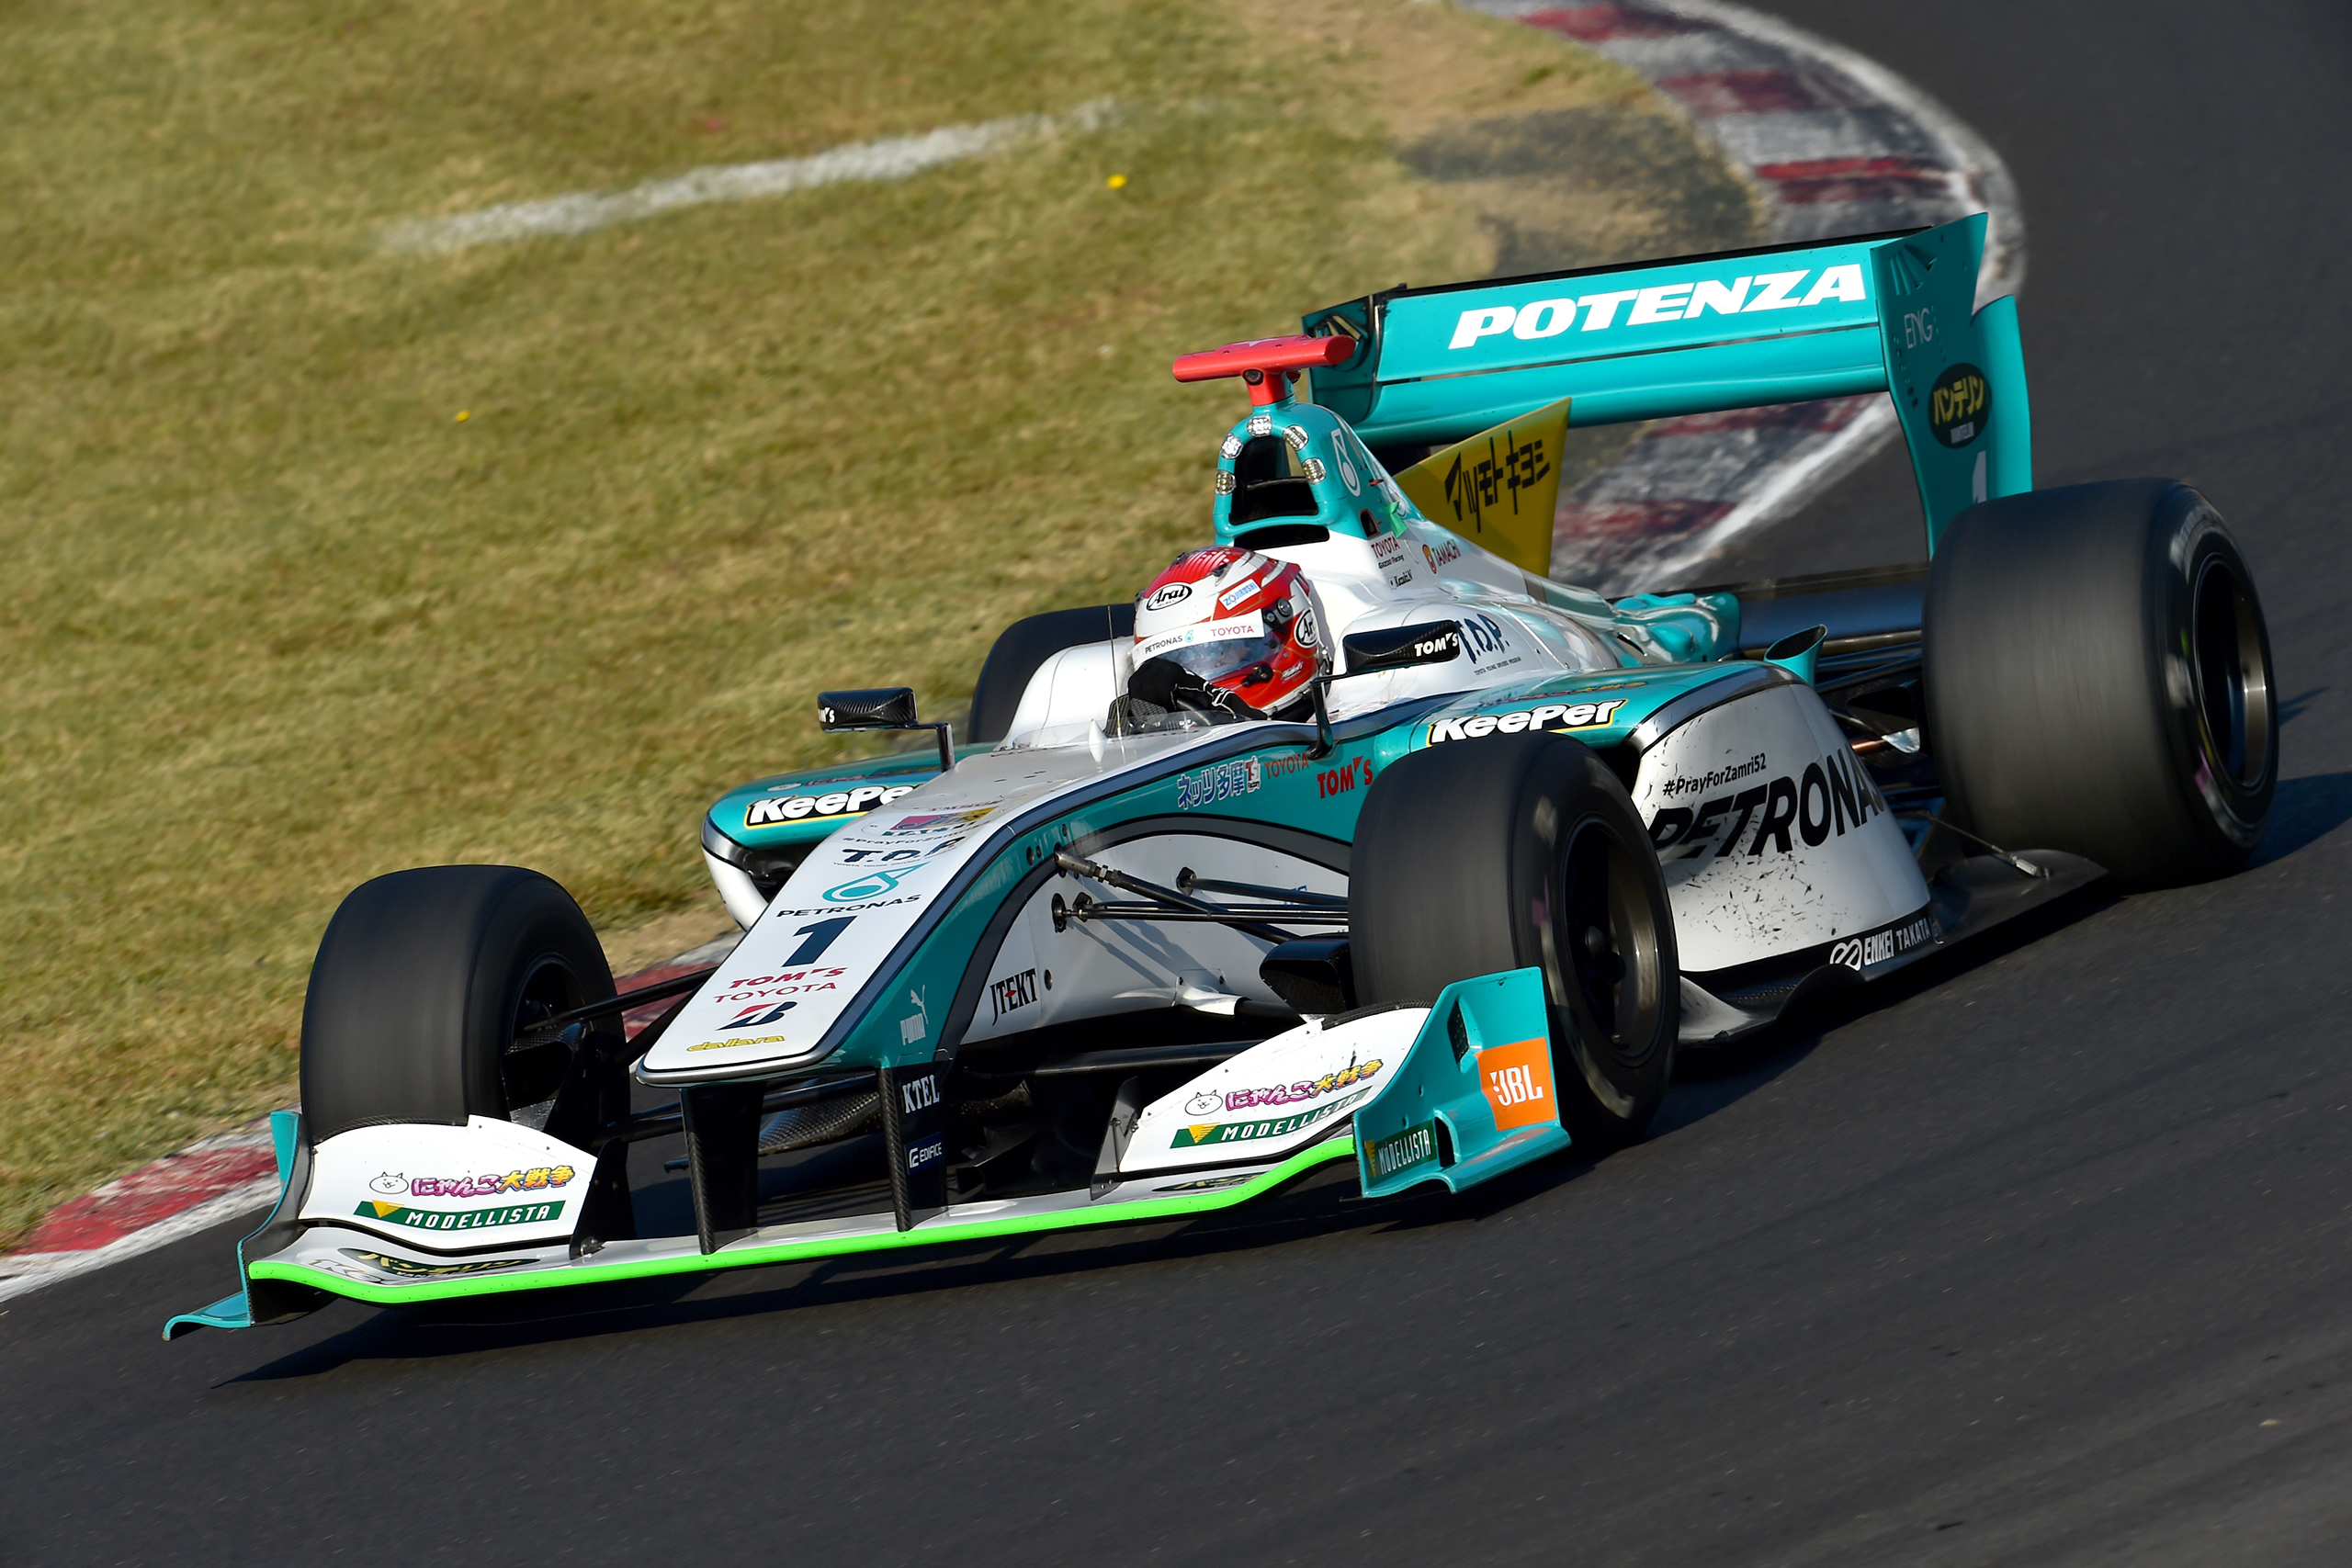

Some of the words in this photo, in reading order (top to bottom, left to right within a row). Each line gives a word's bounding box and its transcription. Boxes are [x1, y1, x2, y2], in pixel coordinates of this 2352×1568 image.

[1448, 264, 1866, 350] POTENZA
[1933, 375, 1984, 425] バンテリン
[1371, 536, 1401, 558] TOYOTA
[1148, 585, 1186, 607] Arai
[1145, 635, 1182, 654] PETRONAS
[1211, 626, 1254, 637] TOYOTA
[1414, 632, 1459, 657] TOM'S
[1264, 752, 1310, 779] TOYOTA
[1317, 756, 1374, 799] TOM'S
[1663, 752, 1767, 796] #PrayForZamri52
[1177, 760, 1245, 810] ネッツ多摩
[750, 784, 917, 824] KeePe
[776, 894, 922, 919] PETRONAS
[781, 915, 859, 967] 1
[1863, 929, 1894, 966] ENKEI
[1895, 917, 1931, 951] TAKATA
[714, 981, 838, 1003] TOYOTA
[729, 966, 849, 989] TOM'S
[990, 967, 1038, 1027] JTEKT
[686, 1034, 786, 1052] dallara
[899, 1012, 926, 1045] PUMA
[901, 1075, 940, 1114] KTEL
[1226, 1059, 1384, 1111] にゃんこ大戦争
[1490, 1064, 1544, 1107] JBL
[1221, 1094, 1358, 1141] MODELLISTA
[920, 1142, 943, 1162] EDIFICE
[1378, 1128, 1431, 1174] MODELLISTA
[412, 1165, 575, 1198] にゃんこ大戦争
[405, 1206, 550, 1230] MODELLISTA
